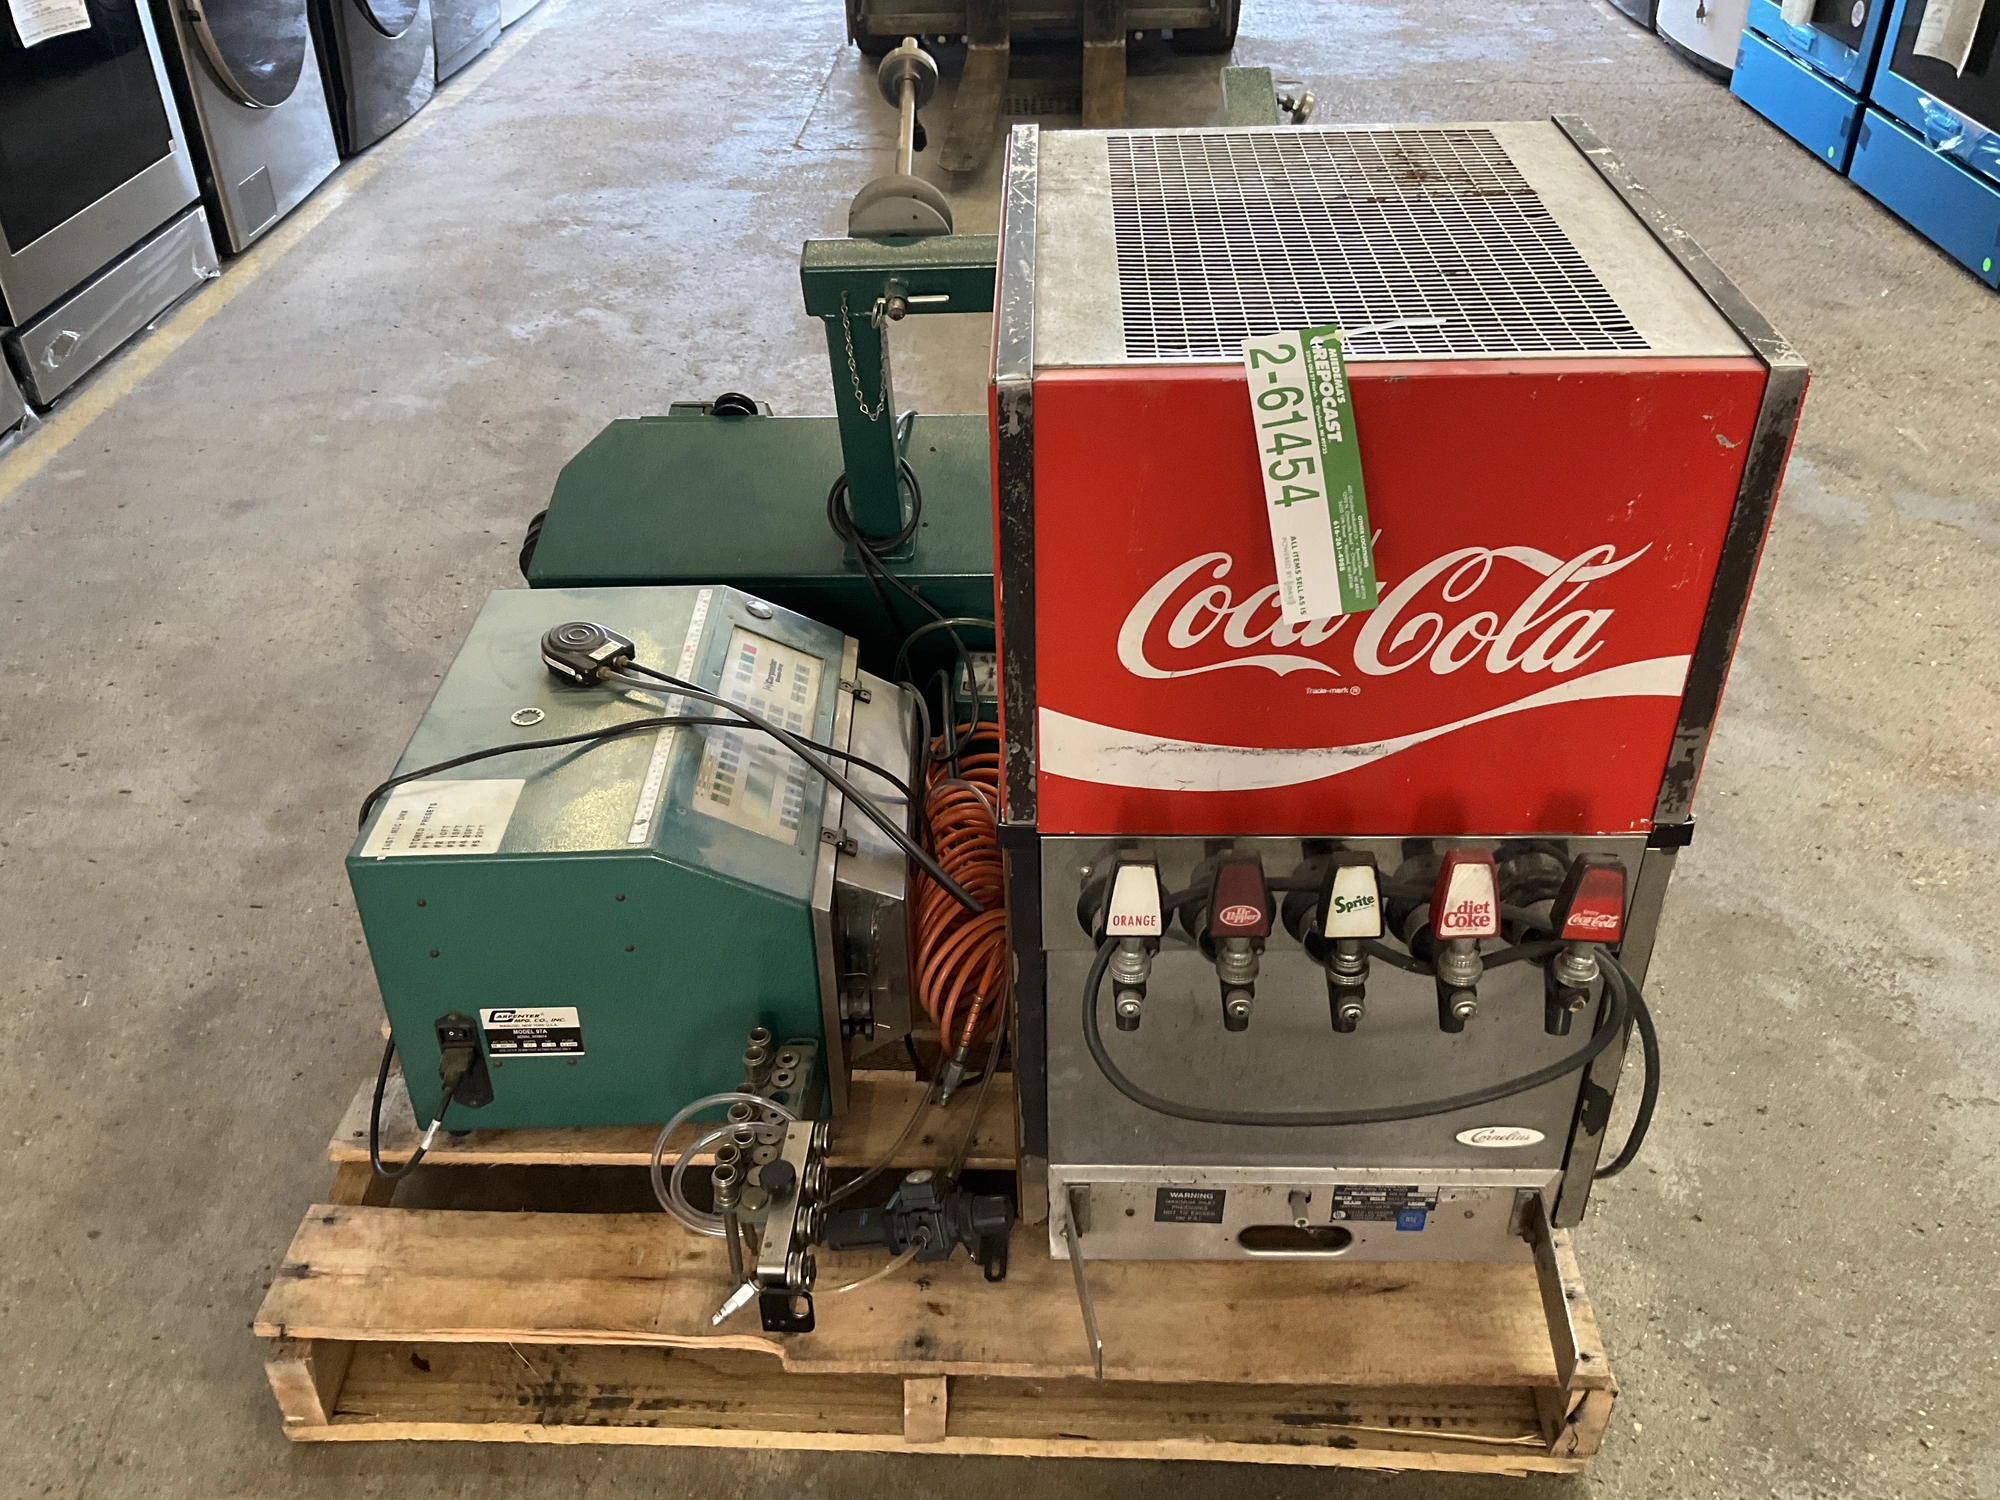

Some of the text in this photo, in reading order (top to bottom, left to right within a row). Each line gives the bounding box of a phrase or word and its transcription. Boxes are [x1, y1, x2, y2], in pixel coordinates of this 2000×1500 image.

[1312, 346, 1342, 444] REPOCAST
[1327, 346, 1345, 404] MIEDEMA'S
[1249, 342, 1320, 509] 2-61454
[1280, 536, 1292, 578] POWERED BY
[1332, 519, 1345, 571] 616-261-4988
[1359, 535, 1369, 567] LOCATIONS
[1289, 535, 1306, 615] ALL ITEMS SELL AS IS
[1117, 529, 1652, 679] CocCola
[1305, 686, 1349, 694] Trade-mark
[408, 827, 425, 848] STORED
[419, 802, 437, 825] PRESETS
[1113, 915, 1157, 927] ORANGE
[1334, 895, 1376, 914] Sprite
[1444, 912, 1491, 928] Coke
[1457, 900, 1490, 914] diet
[1471, 1128, 1530, 1143] Cornelius
